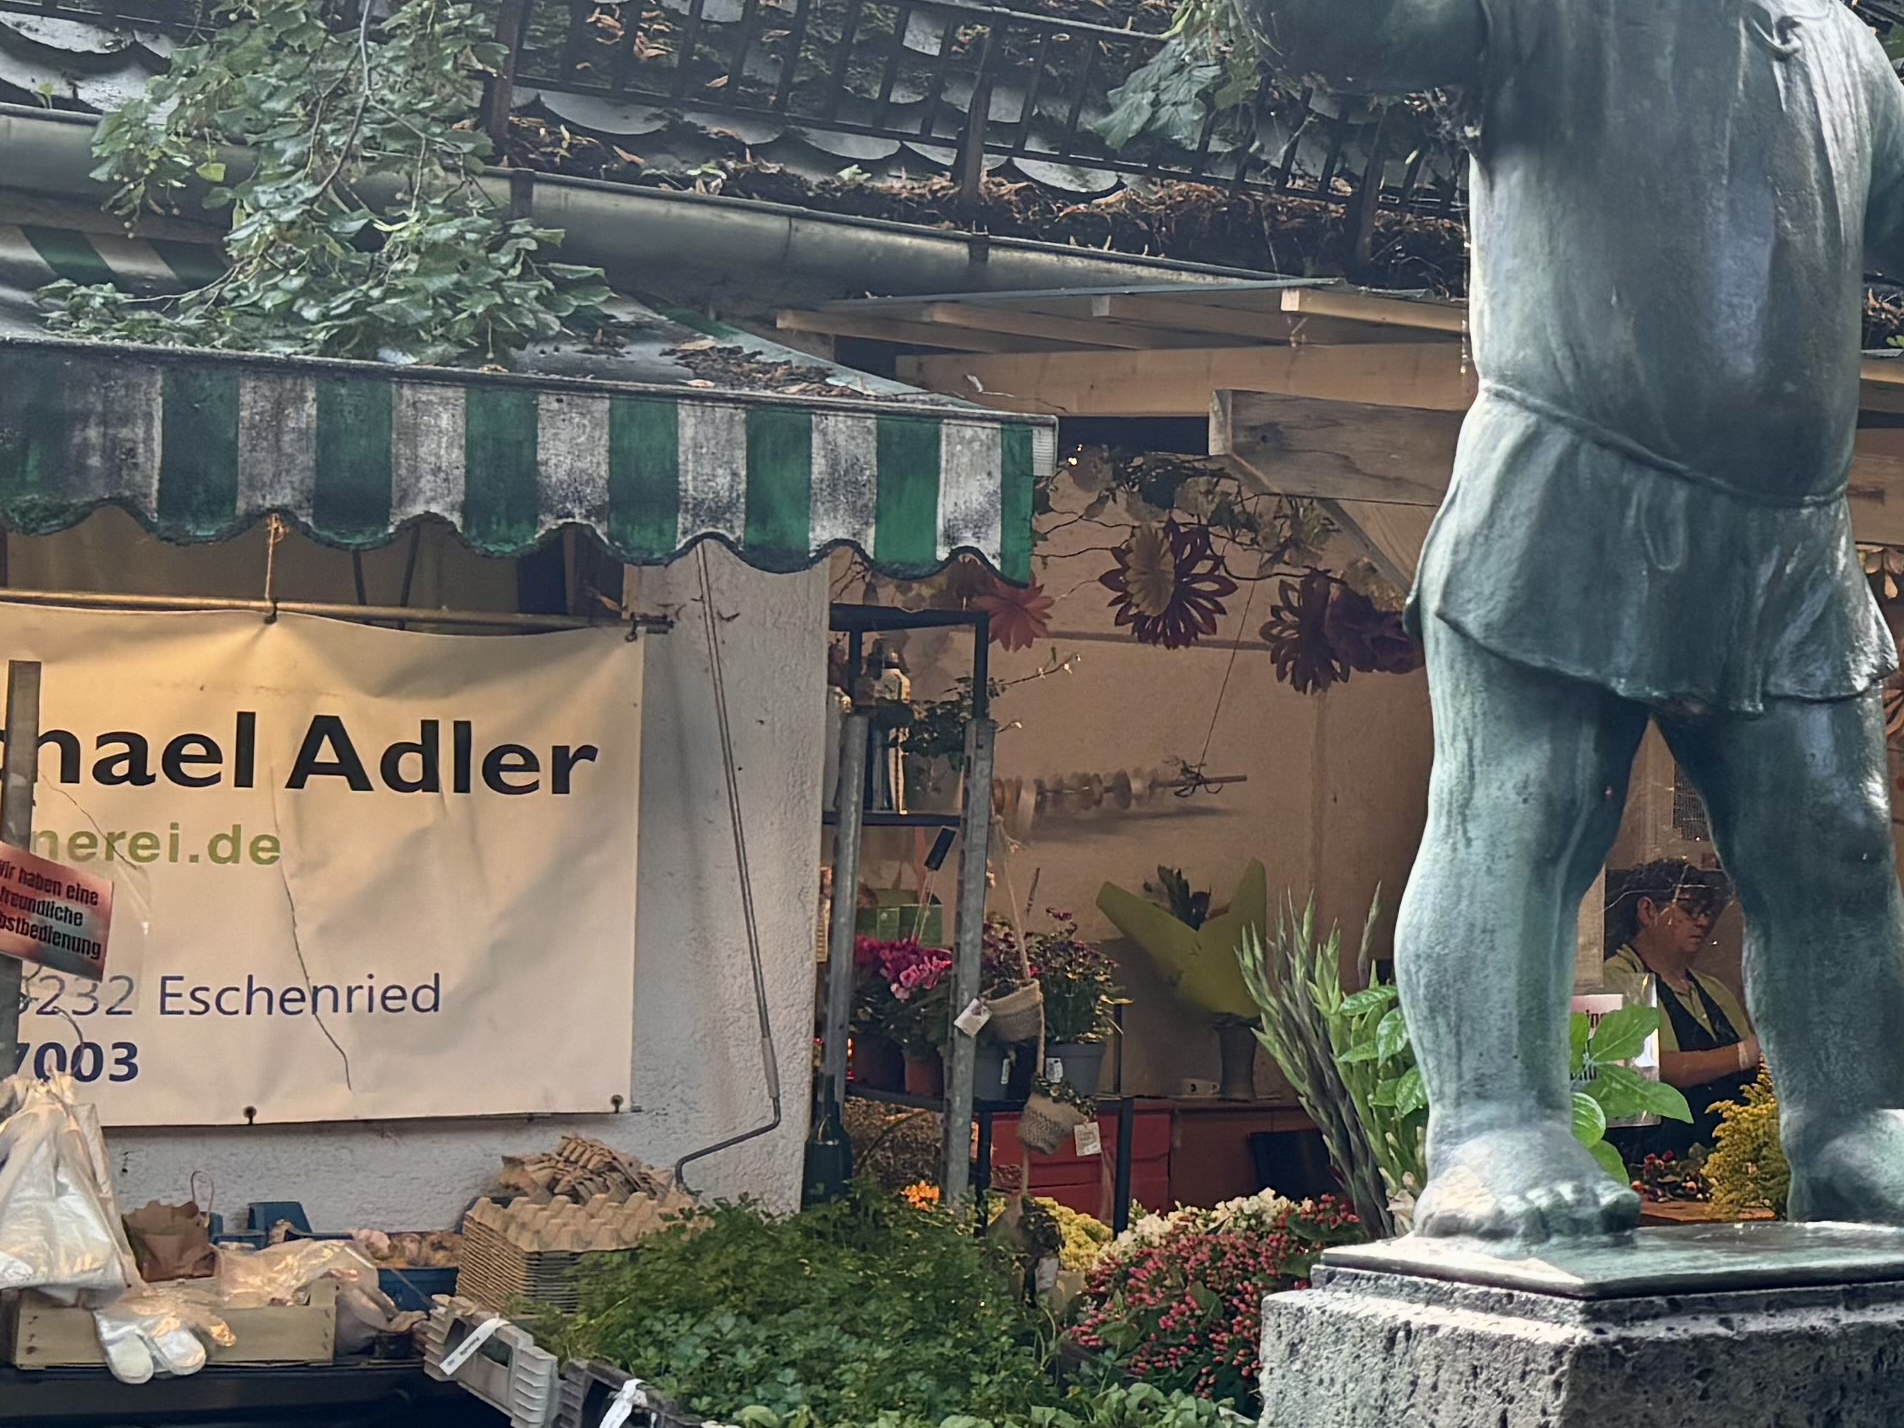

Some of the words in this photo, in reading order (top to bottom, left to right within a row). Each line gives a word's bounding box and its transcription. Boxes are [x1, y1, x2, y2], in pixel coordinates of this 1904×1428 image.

[0, 711, 256, 789] hael
[285, 714, 600, 795] Adler
[18, 867, 62, 897] haben
[66, 882, 99, 906] eine
[159, 973, 441, 1016] Eschenried
